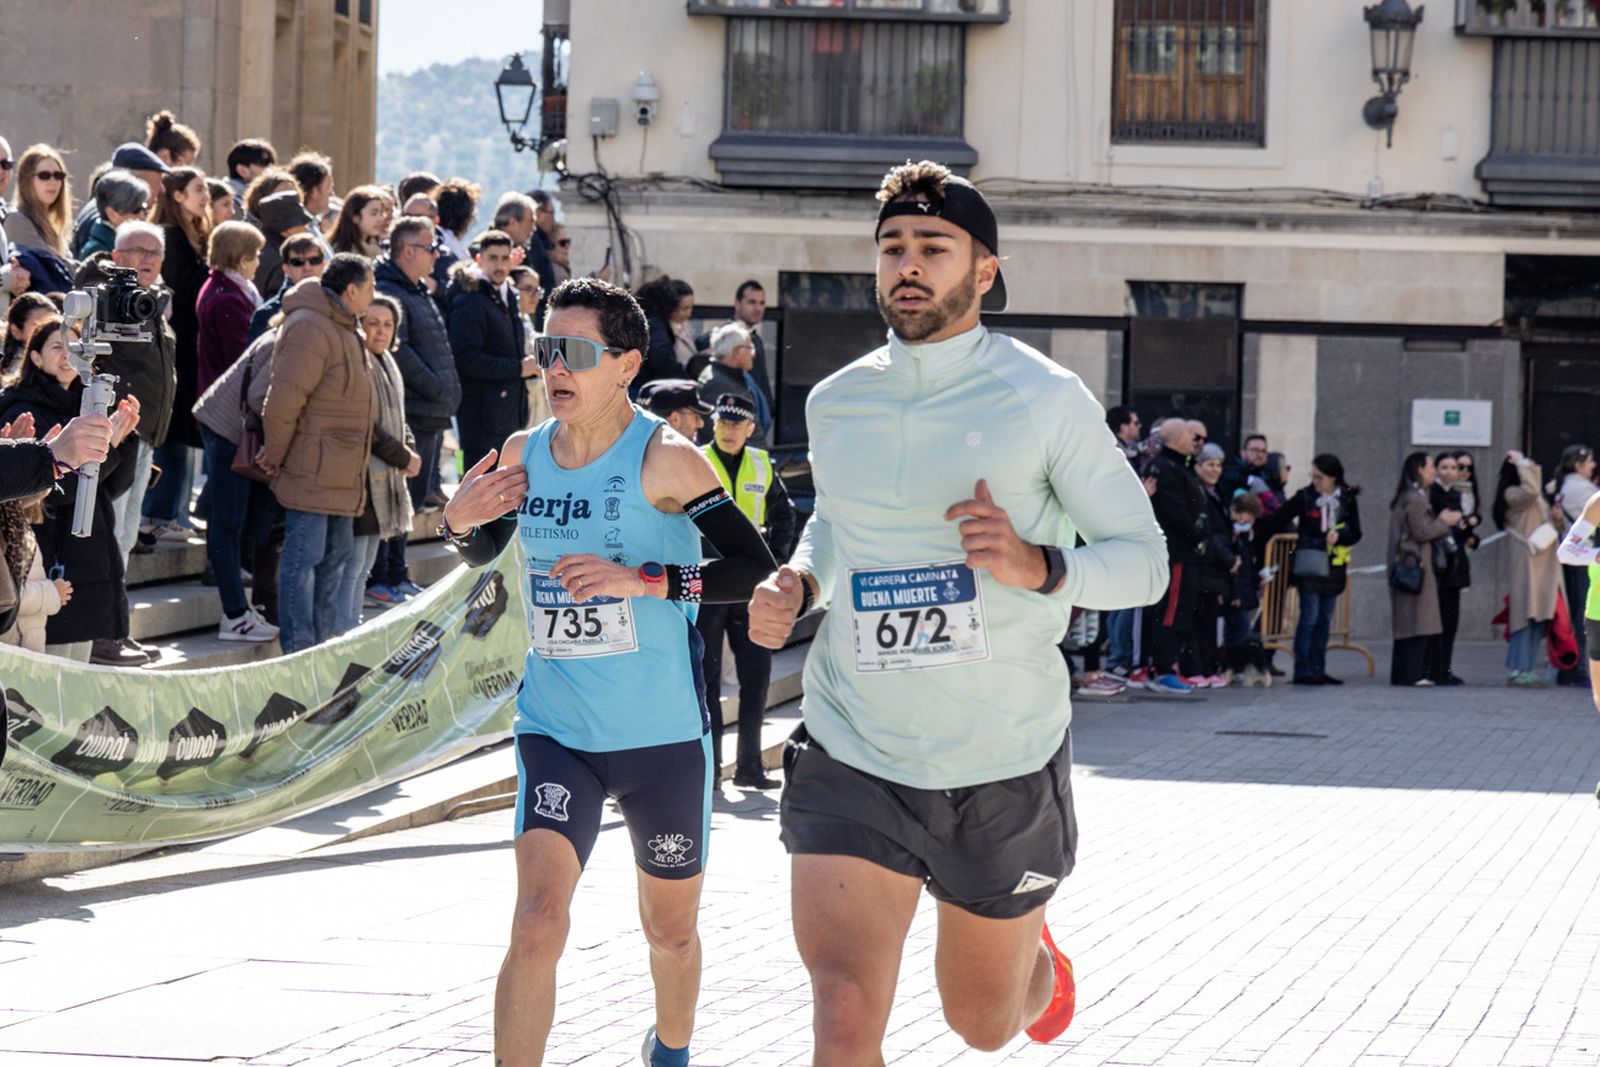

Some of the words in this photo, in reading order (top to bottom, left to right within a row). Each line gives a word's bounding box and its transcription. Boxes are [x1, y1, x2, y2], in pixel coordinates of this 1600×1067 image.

[868, 574, 907, 586] CARRERA
[908, 569, 959, 583] CAMINATA
[860, 590, 892, 607] BUENA
[893, 586, 938, 605] MUERTE
[543, 607, 602, 639] 735
[876, 607, 951, 649] 672
[75, 733, 131, 762] ownat
[175, 728, 219, 761] ownat
